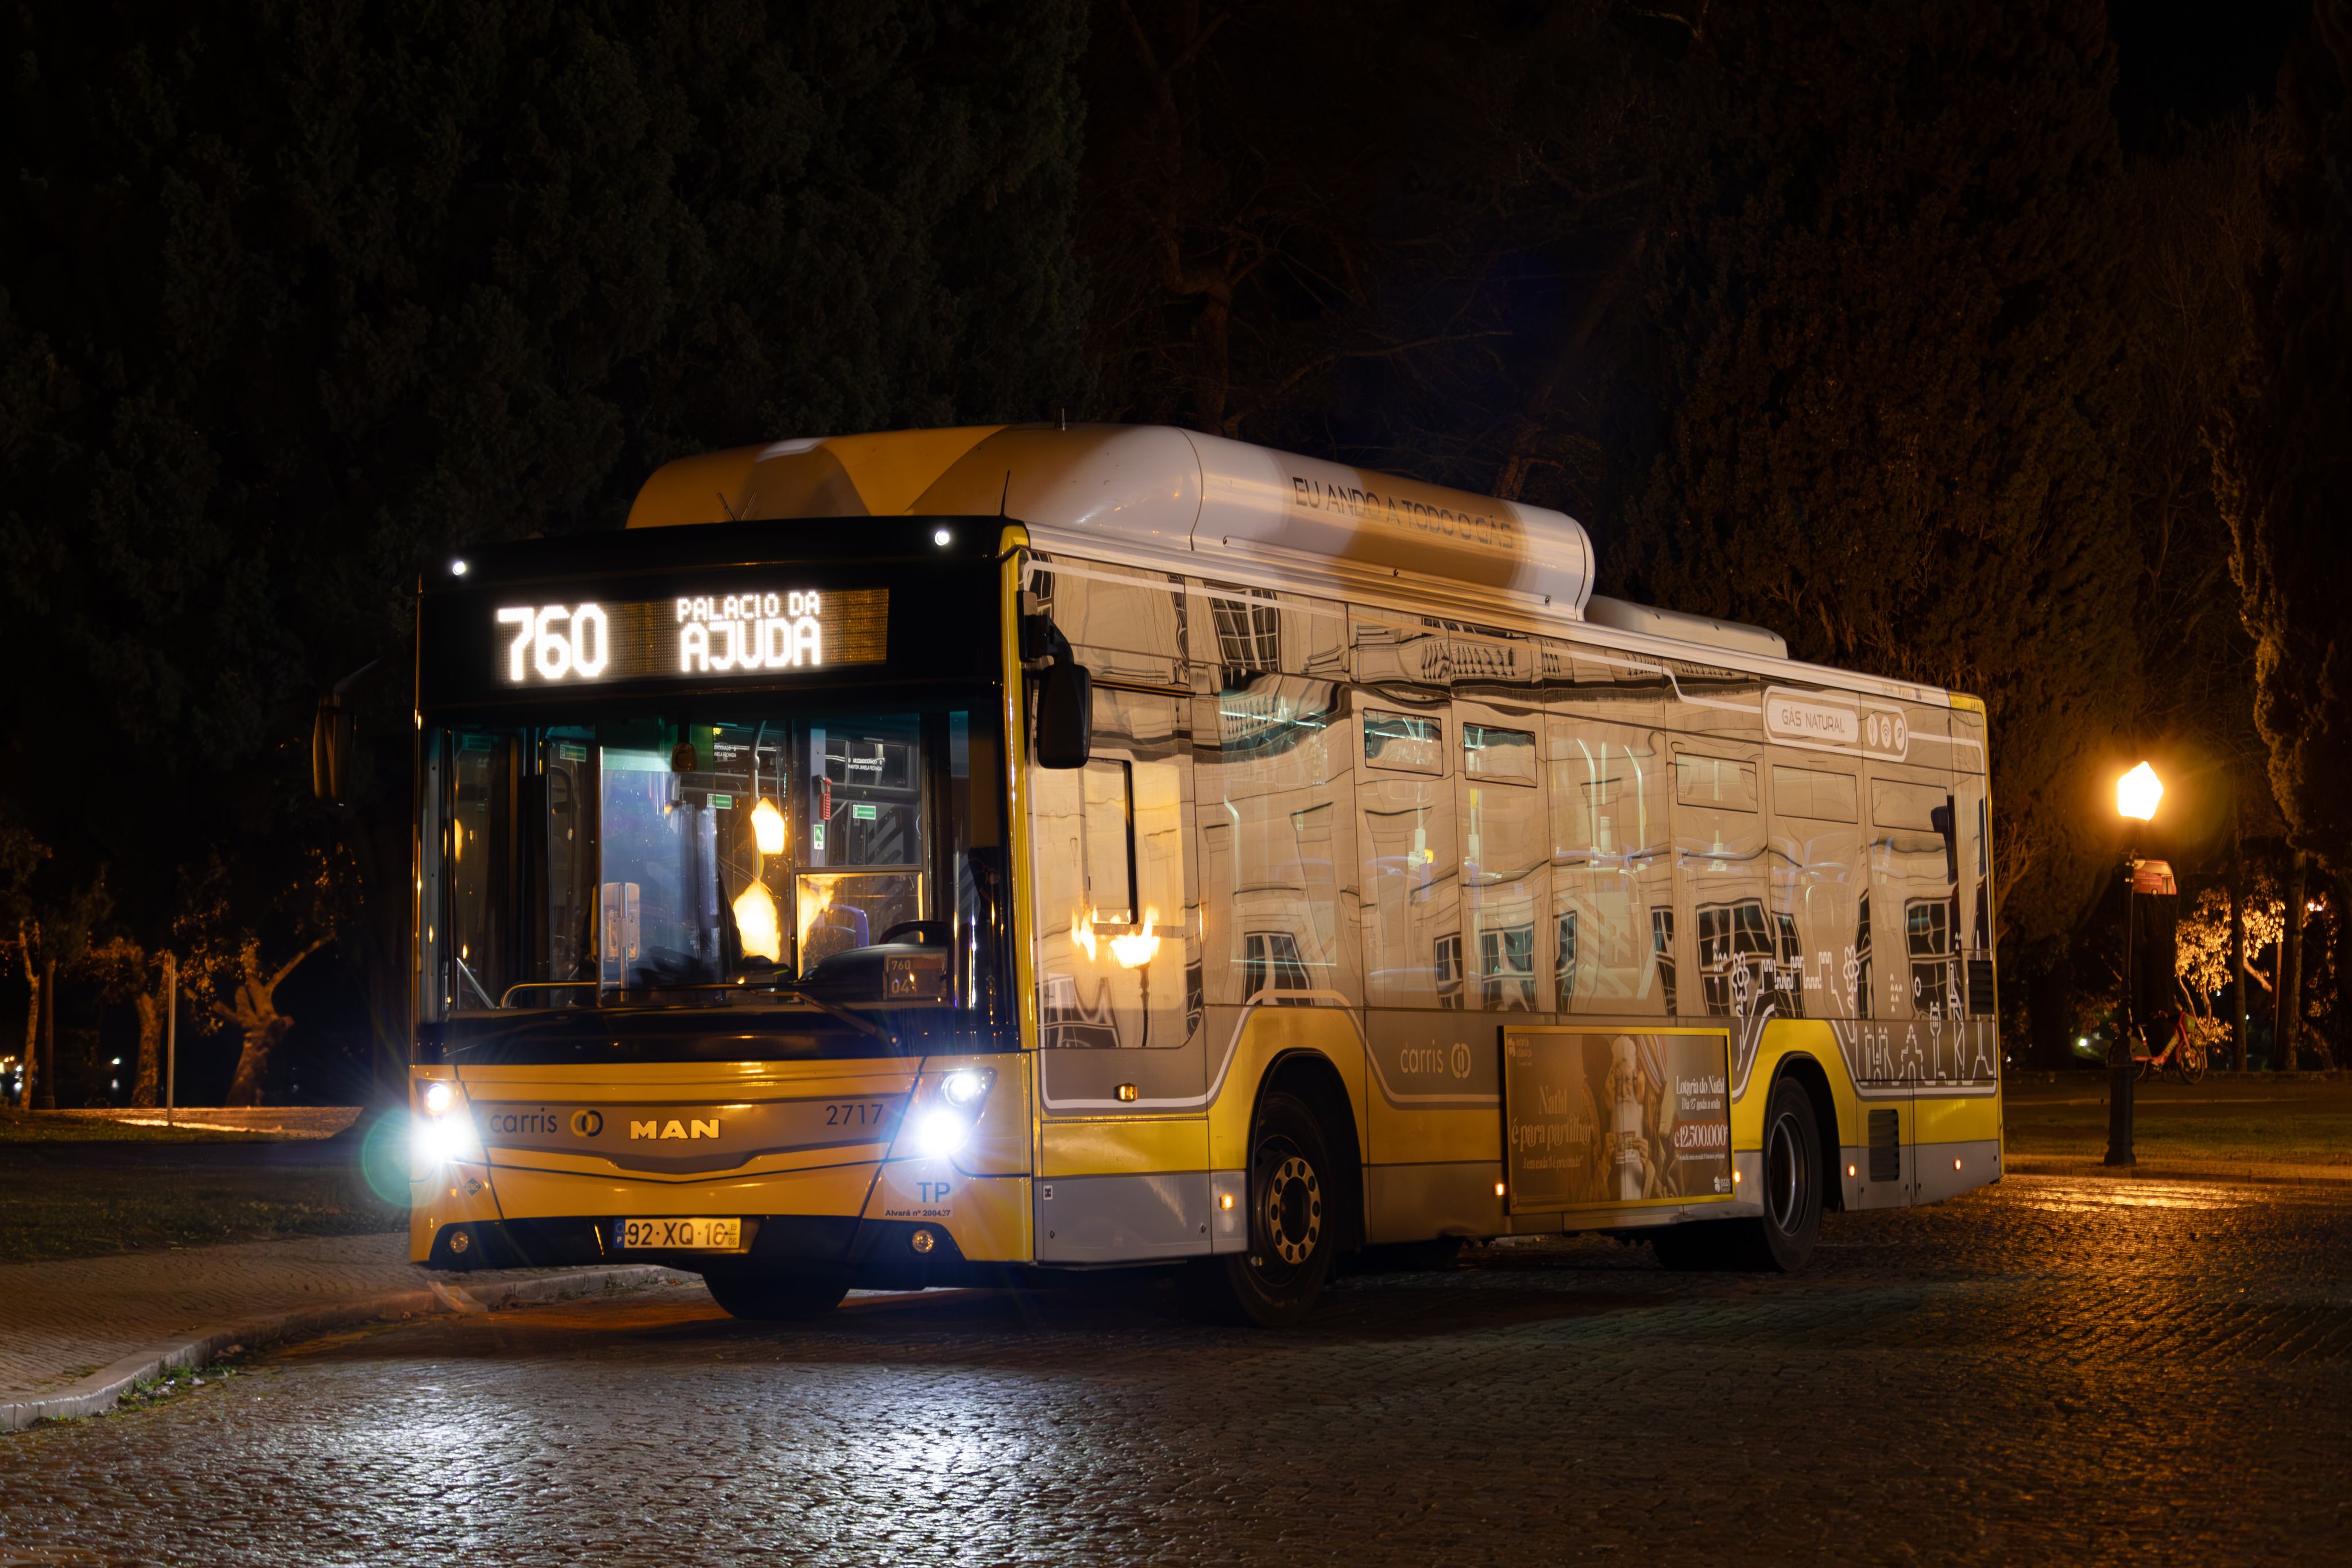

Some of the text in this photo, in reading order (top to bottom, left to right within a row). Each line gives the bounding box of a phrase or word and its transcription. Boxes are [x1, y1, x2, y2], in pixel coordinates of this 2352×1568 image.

[1293, 477, 1513, 548] EU ANDO A TODO O GÁS
[677, 591, 820, 622] PALACIO DA
[497, 603, 608, 681] 760
[681, 615, 821, 672] AJUDA
[1782, 707, 1846, 733] GÁS NATURAL
[892, 960, 911, 970] 760
[1400, 1039, 1444, 1074] carris
[1676, 1075, 1725, 1096] Lotaria do Natal
[490, 1108, 557, 1133] carris
[826, 1104, 883, 1125] 2717
[630, 1118, 720, 1139] MAN
[1511, 1114, 1594, 1152] é para partilhar
[916, 1182, 951, 1203] TP
[730, 1223, 737, 1232] 19
[616, 1236, 622, 1244] P
[728, 1237, 737, 1245] 06
